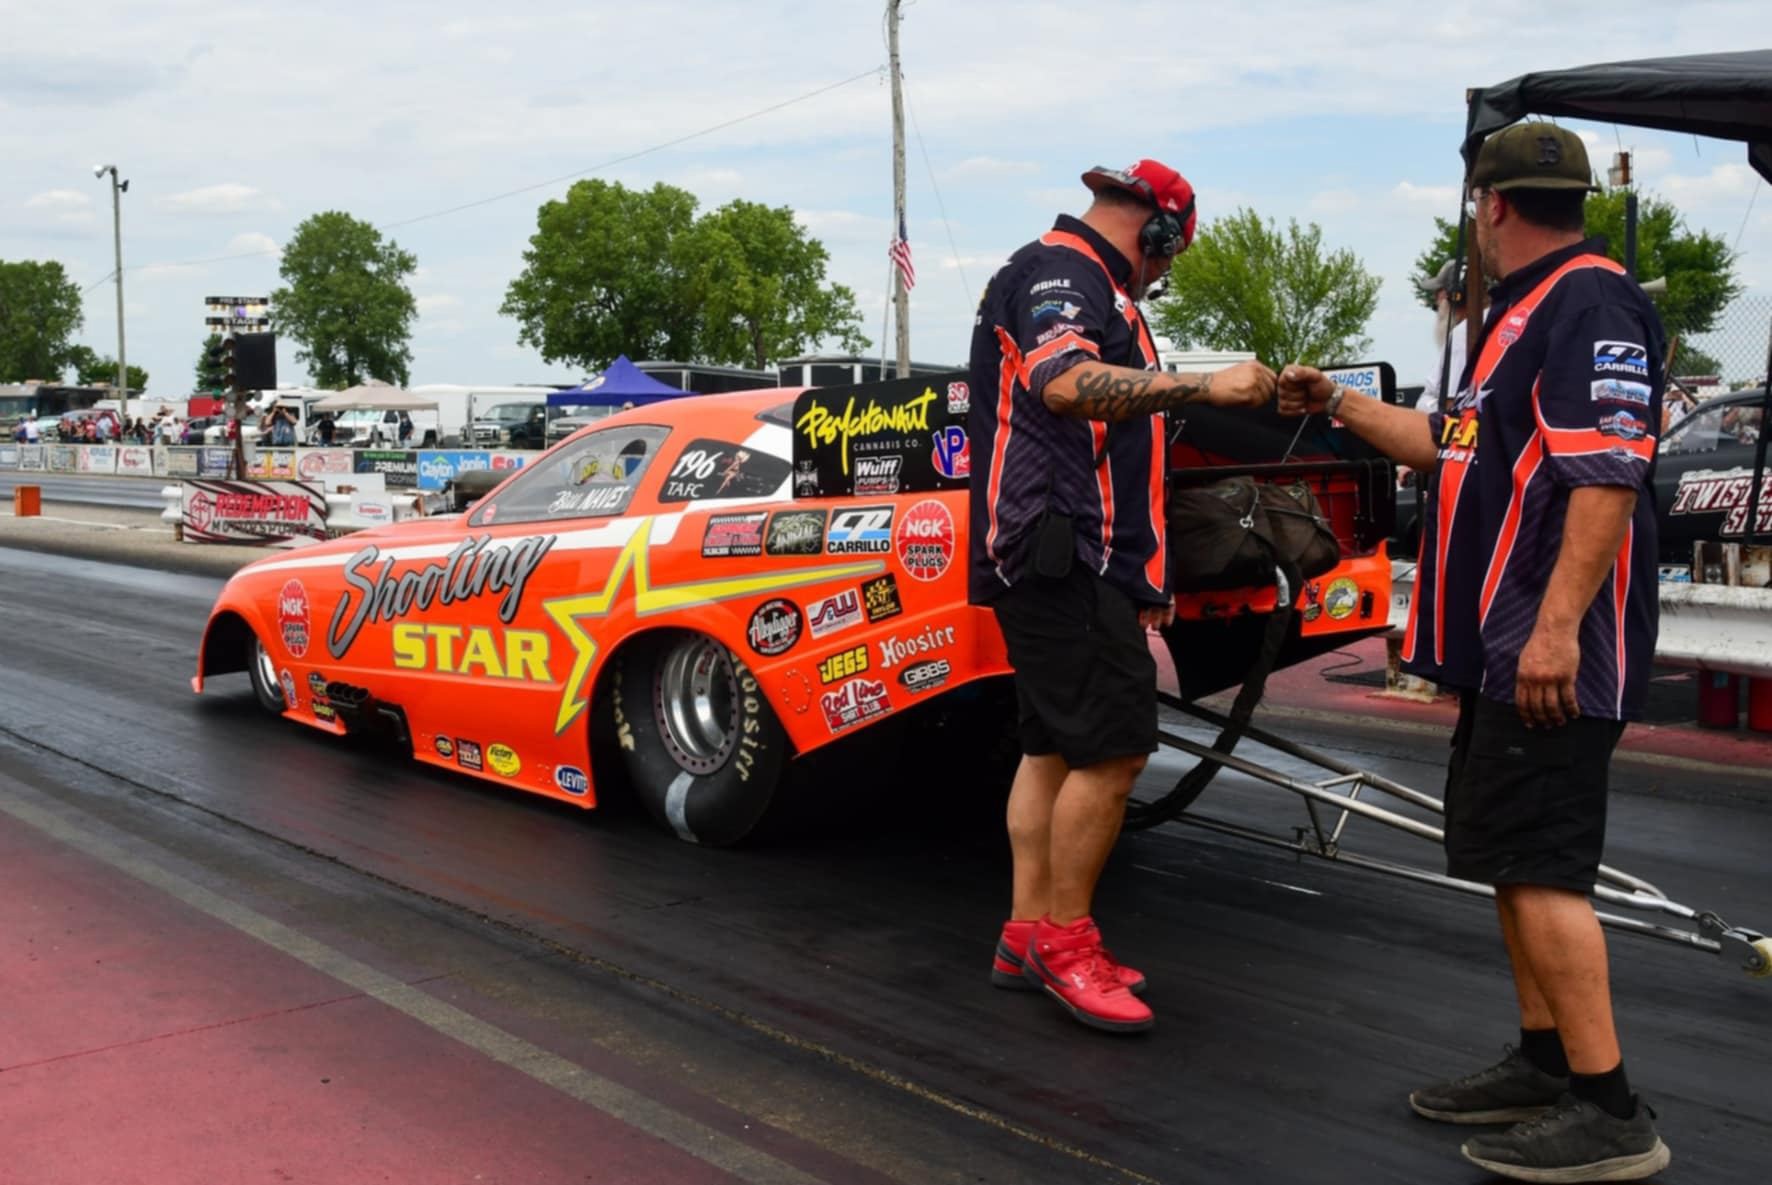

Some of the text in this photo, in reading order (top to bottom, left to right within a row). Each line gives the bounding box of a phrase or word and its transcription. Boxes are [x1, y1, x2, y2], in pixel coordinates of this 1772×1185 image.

[671, 450, 724, 480] 196
[857, 459, 897, 476] Wulff
[215, 494, 311, 521] REDEMPTION
[906, 518, 943, 538] NGK
[827, 539, 890, 553] CARRILLO
[907, 543, 943, 555] SPARK
[907, 556, 944, 568] PLUGS
[282, 599, 305, 616] NGK
[327, 533, 557, 661] Shooting
[391, 624, 554, 683] STAR
[879, 625, 955, 669] Hoosier
[818, 645, 868, 683] JEGS
